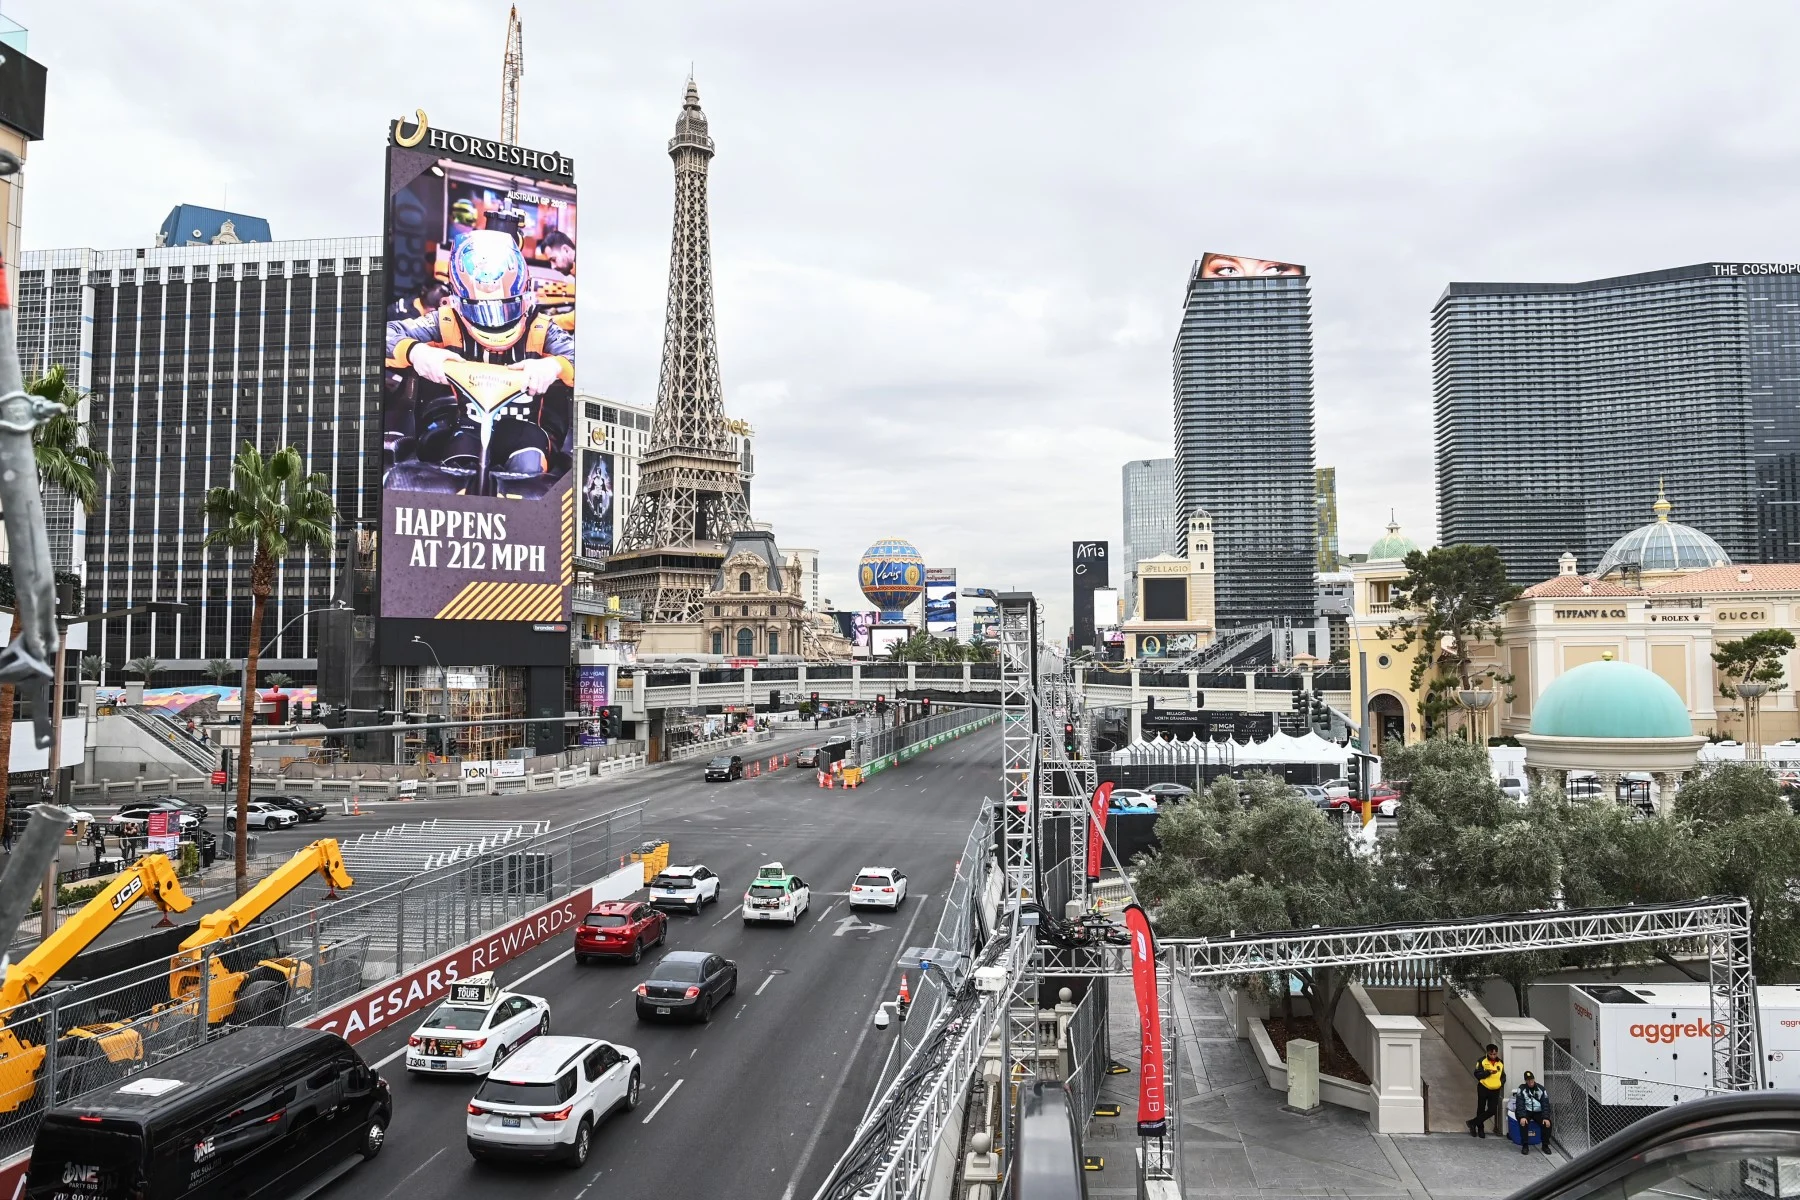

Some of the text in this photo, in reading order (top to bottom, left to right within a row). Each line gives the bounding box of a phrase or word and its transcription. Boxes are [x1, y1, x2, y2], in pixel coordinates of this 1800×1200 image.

[507, 190, 539, 204] AUSTRALIA
[1713, 264, 1738, 276] THE
[395, 507, 506, 541] HAPPENS
[409, 539, 546, 572] AT 212 MPH
[1077, 543, 1105, 559] Aria
[875, 560, 902, 589] Paris
[1142, 565, 1188, 574] BELLAGIO
[1555, 609, 1599, 619] TIFFANY
[1601, 609, 1608, 618] &
[1718, 612, 1765, 620] GUCCI
[113, 876, 141, 909] JCB
[457, 989, 479, 998] TOURS
[1574, 1002, 1593, 1021] aggreko
[1629, 1017, 1725, 1044] aggreko
[410, 1057, 426, 1067] 7303
[1143, 1063, 1160, 1112] CLUB
